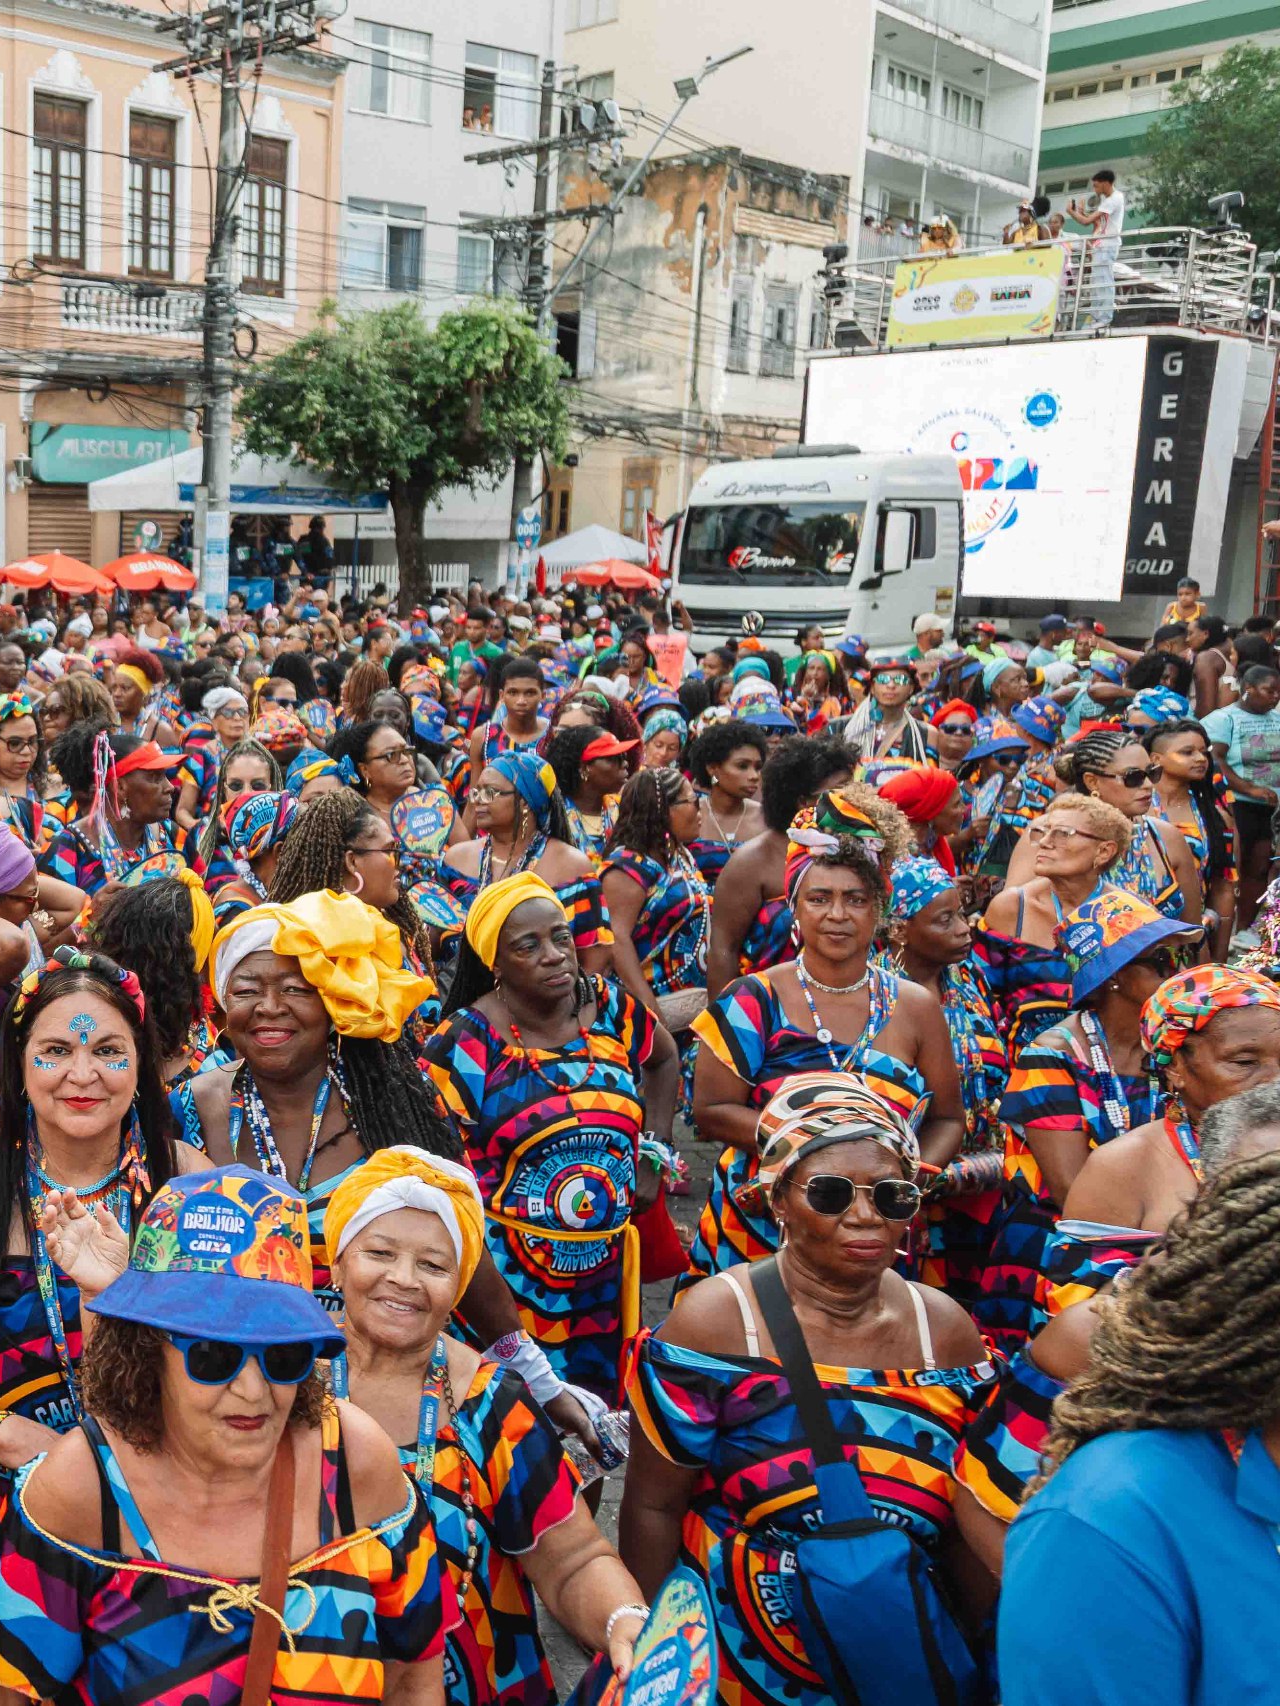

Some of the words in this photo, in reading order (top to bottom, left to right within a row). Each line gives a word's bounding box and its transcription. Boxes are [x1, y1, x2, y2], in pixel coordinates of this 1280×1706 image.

[1125, 558, 1174, 576] GOLD
[542, 1134, 610, 1157] CARNAVAL
[531, 1202, 541, 1212] DI
[183, 1212, 246, 1235] BRILHAR
[189, 1240, 232, 1254] CAIXA
